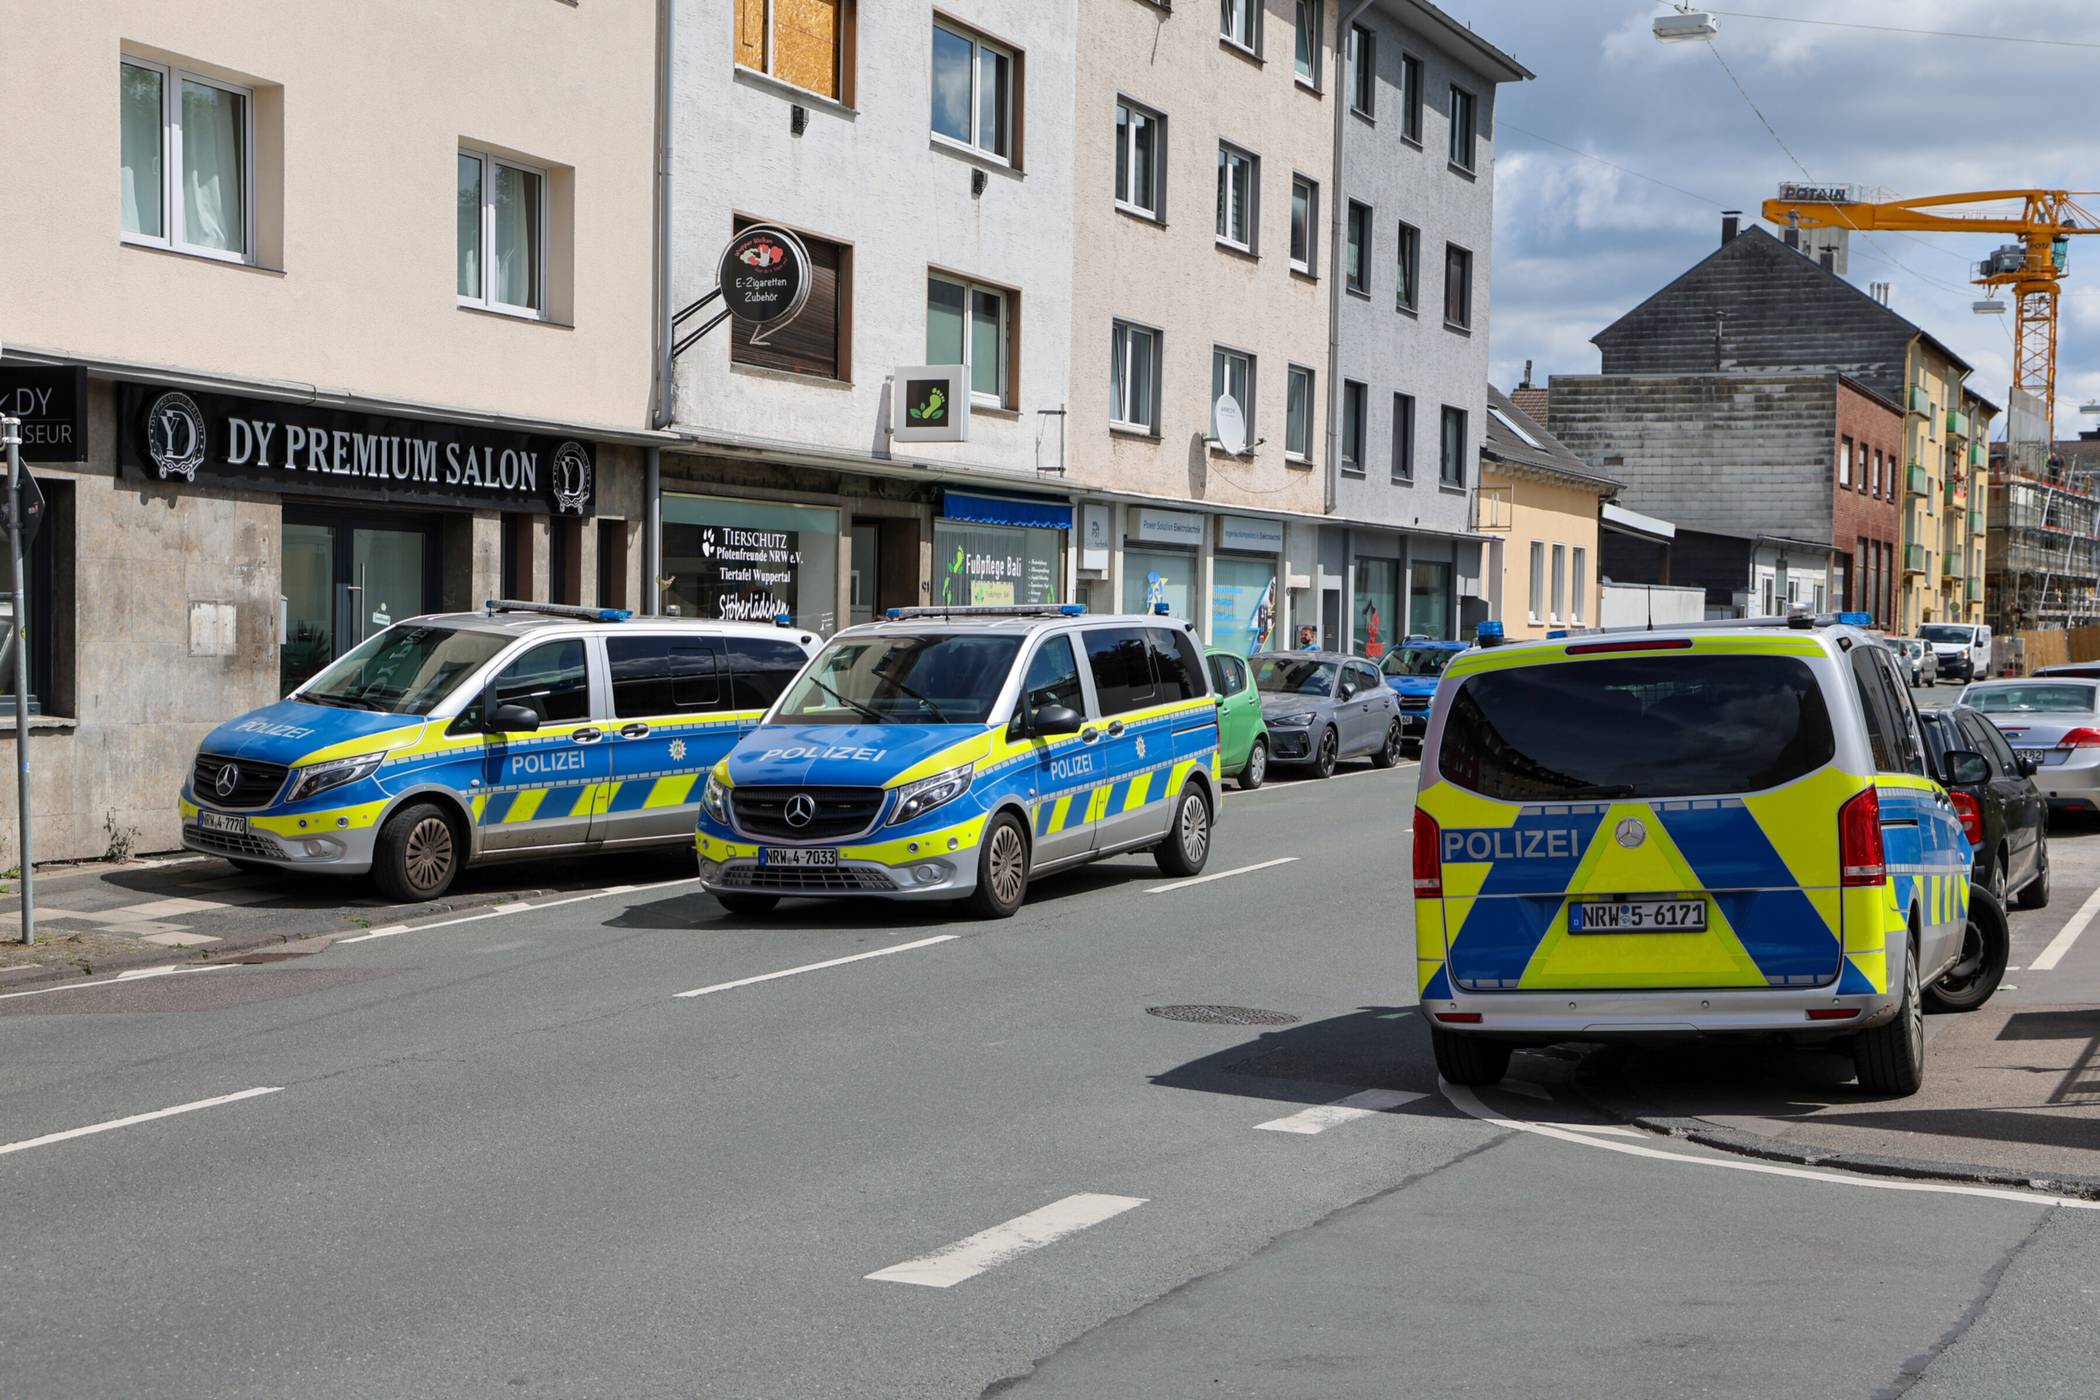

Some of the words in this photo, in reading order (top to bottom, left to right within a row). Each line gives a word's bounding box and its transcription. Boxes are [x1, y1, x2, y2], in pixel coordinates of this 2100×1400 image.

[1784, 186, 1847, 201] POTAIN
[735, 276, 787, 290] E-Zigaretten
[744, 291, 778, 302] Zubehör
[17, 387, 53, 416] DY
[227, 416, 276, 466] DY
[284, 423, 439, 483] PREMIUM
[445, 442, 538, 492] SALON
[722, 528, 788, 549] TIERSCHUTZ
[716, 546, 768, 563] Pfotenfreunde
[768, 550, 789, 563] NRW
[789, 551, 804, 564] e.V.
[720, 567, 752, 581] Tiertafel
[753, 569, 791, 585] Wuppertal
[966, 554, 1004, 580] Fußpflege
[1006, 555, 1022, 577] Bali
[719, 591, 790, 621] Stöberlädchen
[234, 720, 316, 740] POLIZEI
[512, 750, 585, 775] POLIZEI
[759, 746, 887, 762] POLIZEI
[1050, 753, 1093, 781] POLIZEI
[1444, 829, 1579, 860] POLIZEI
[766, 849, 787, 865] NRW
[793, 850, 836, 865] 4-7033
[1582, 906, 1620, 927] NRW
[1631, 903, 1704, 926] 5-6171
